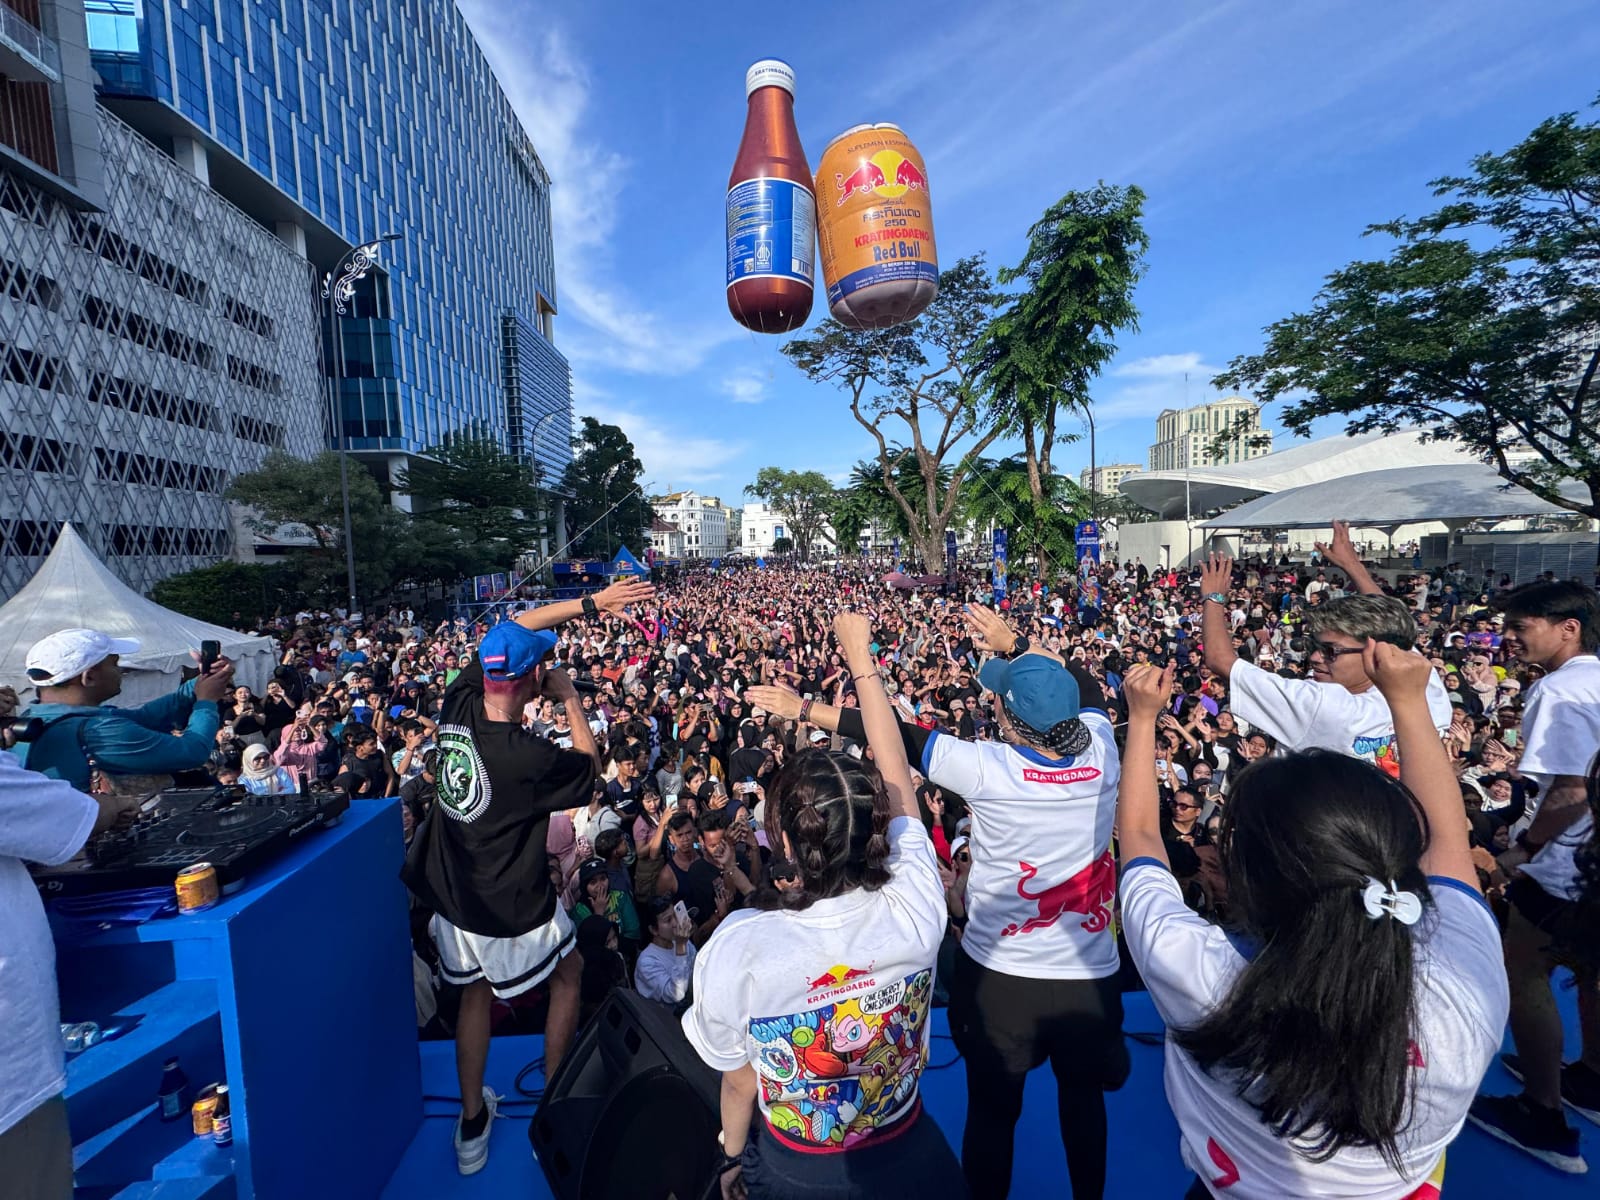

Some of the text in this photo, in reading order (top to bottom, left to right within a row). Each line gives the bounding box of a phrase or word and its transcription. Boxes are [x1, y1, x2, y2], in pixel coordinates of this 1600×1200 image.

[884, 218, 907, 227] 250
[854, 227, 930, 248] KRATINGDAENG
[873, 240, 921, 262] Red Bull
[807, 978, 876, 1004] KRATINGDAENG
[877, 980, 902, 998] ENERGY
[751, 1011, 819, 1044] GAME ON
